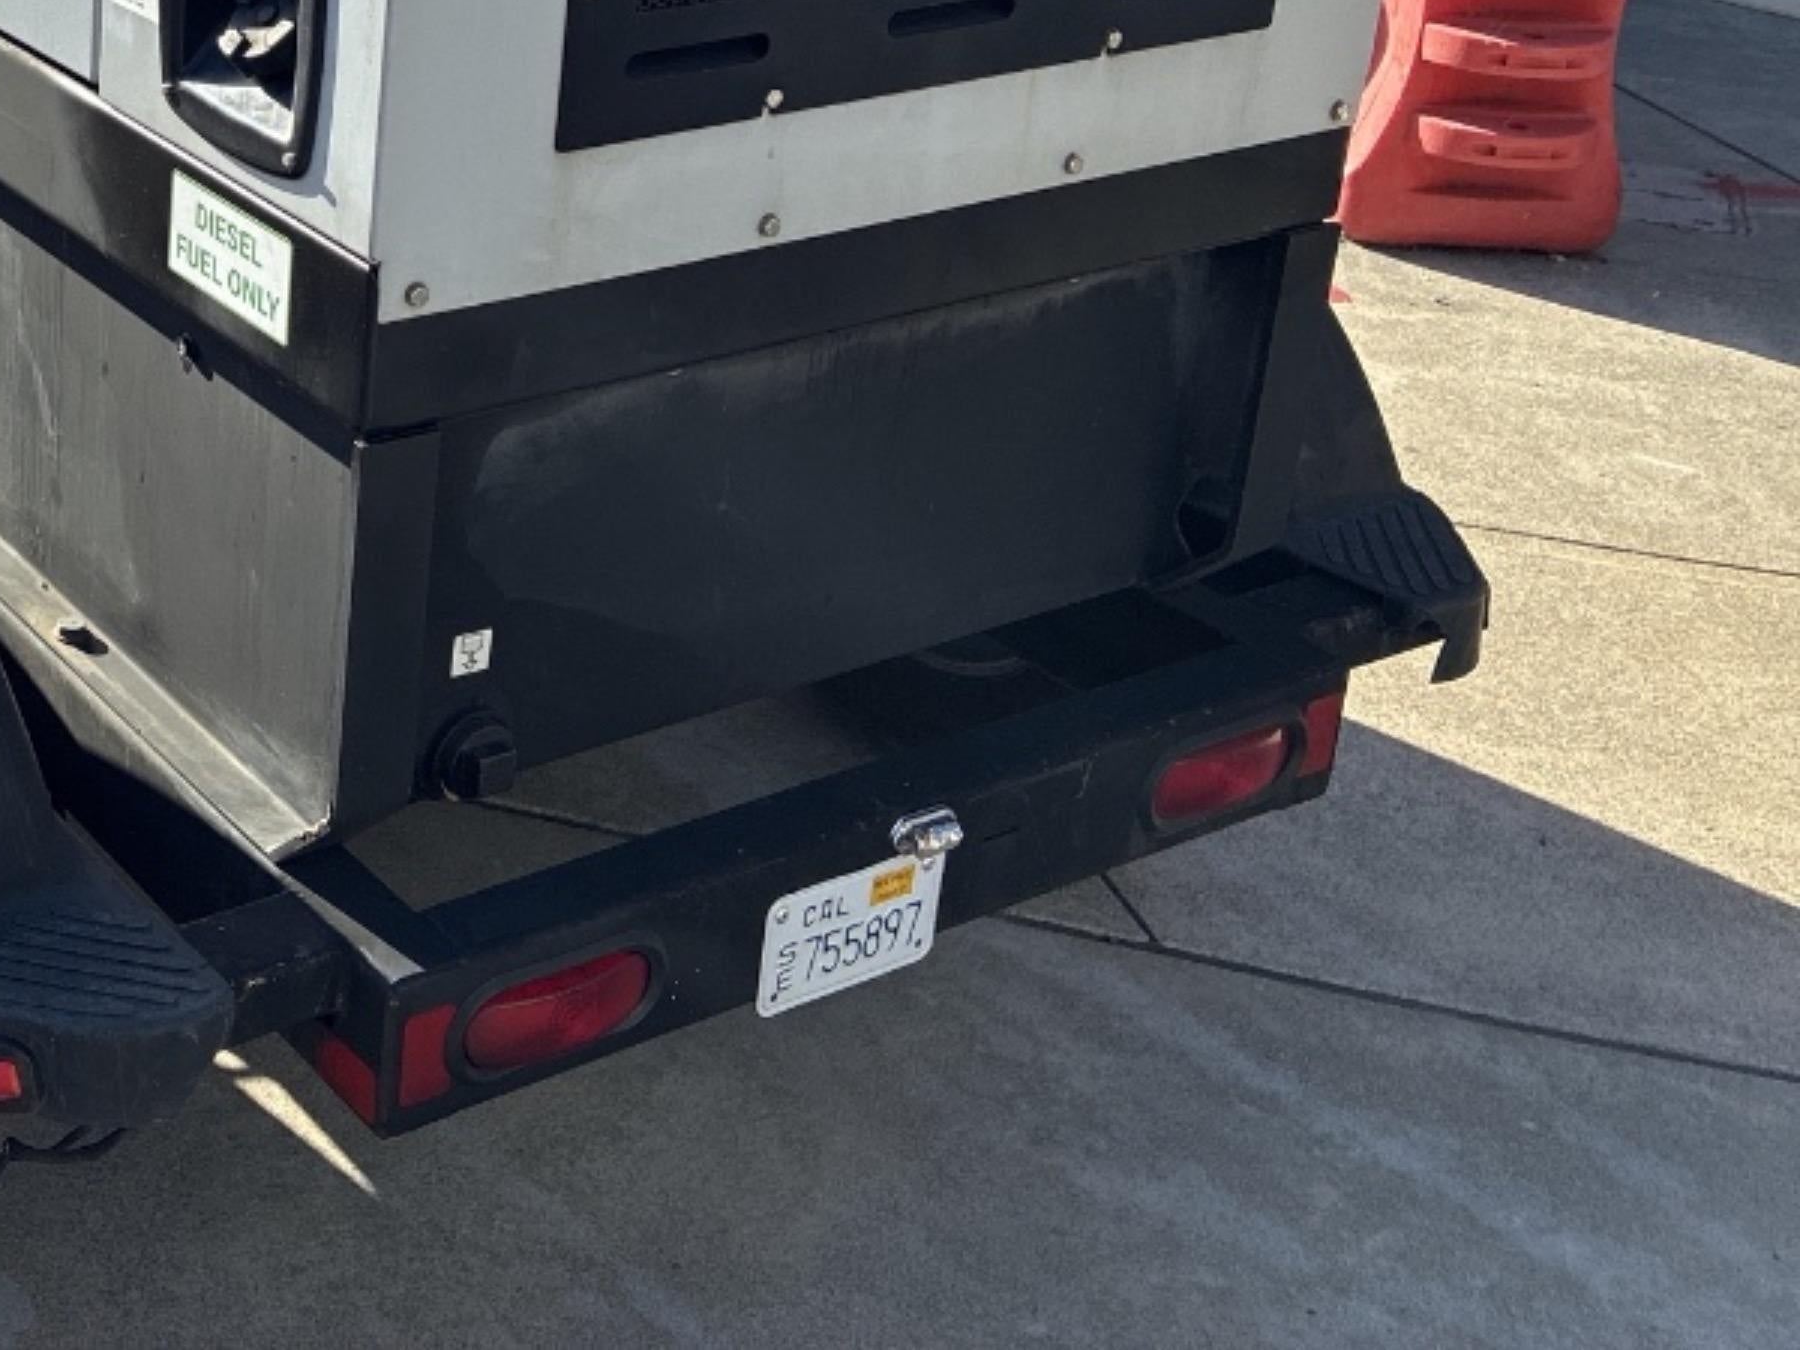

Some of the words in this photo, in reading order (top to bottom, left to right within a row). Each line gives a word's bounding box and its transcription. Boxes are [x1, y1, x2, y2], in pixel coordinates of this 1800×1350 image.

[195, 201, 263, 268] DIESEL
[176, 232, 223, 286] FUEL
[227, 267, 281, 322] ONLY
[802, 896, 849, 928] CAL
[804, 899, 923, 982] 755897
